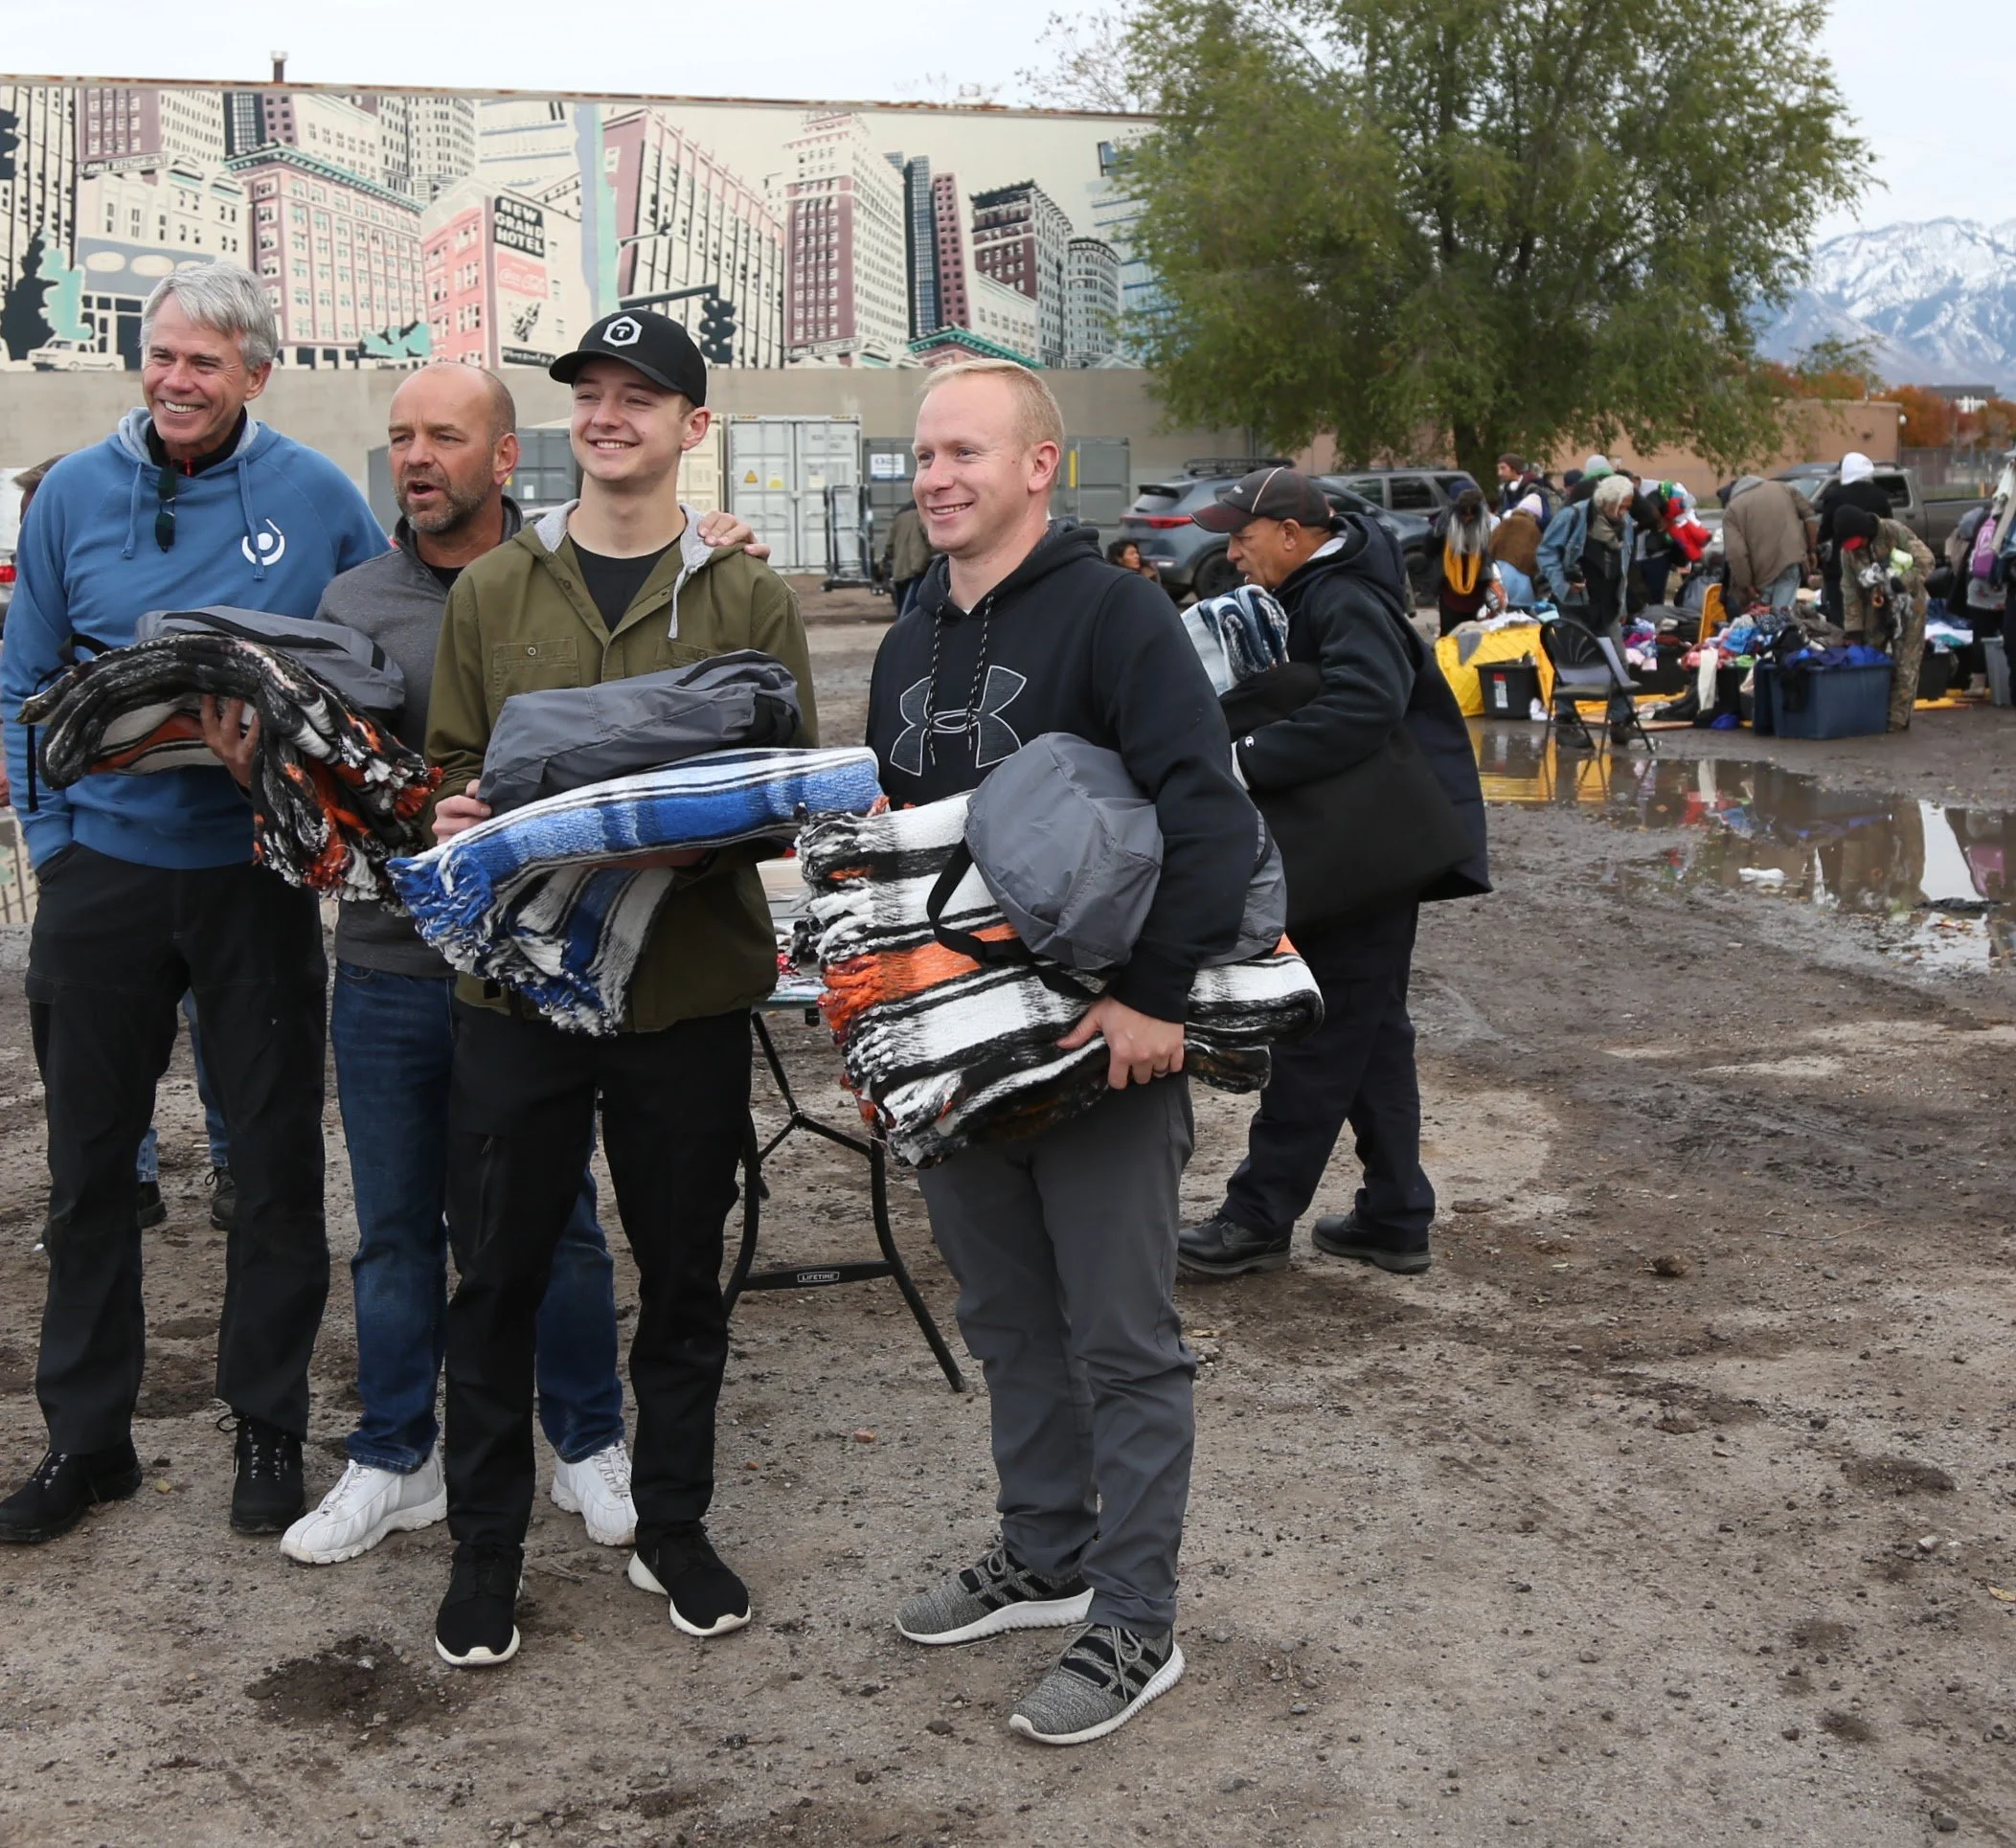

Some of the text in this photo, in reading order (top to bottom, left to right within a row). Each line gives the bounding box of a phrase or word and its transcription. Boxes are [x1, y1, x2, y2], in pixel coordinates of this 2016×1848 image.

[501, 199, 537, 222] NEW
[495, 212, 544, 239] GRAND
[496, 226, 544, 253] HOTEL
